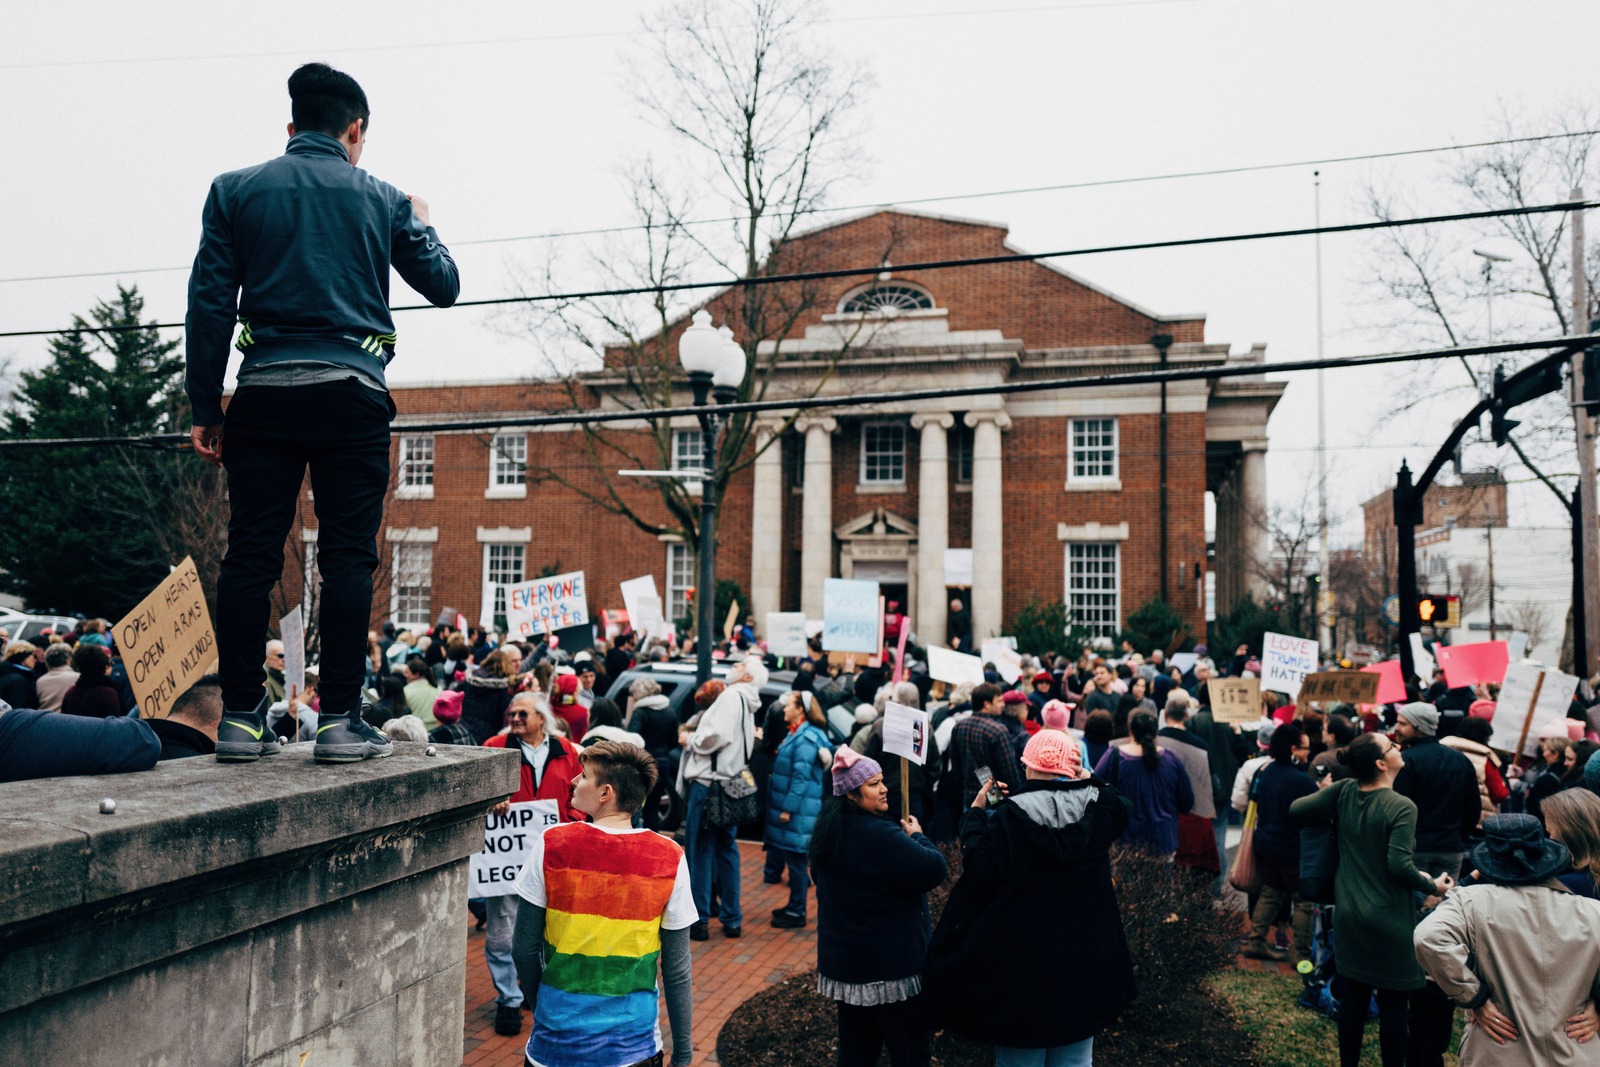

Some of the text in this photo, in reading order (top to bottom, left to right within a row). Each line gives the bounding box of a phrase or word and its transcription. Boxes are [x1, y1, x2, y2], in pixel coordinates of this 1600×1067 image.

[512, 577, 582, 610] EVERYONE
[123, 568, 198, 649] OPEN HEARTS
[533, 604, 567, 621] DOES
[520, 611, 582, 636] BETTER
[133, 601, 202, 683] OPEN ARMS
[1271, 635, 1310, 654] LOVE
[1268, 649, 1311, 669] TRUMPS
[144, 630, 213, 718] OPEN MINDS
[1270, 667, 1306, 683] HATE
[543, 814, 558, 825] IS
[482, 834, 527, 855] NOT
